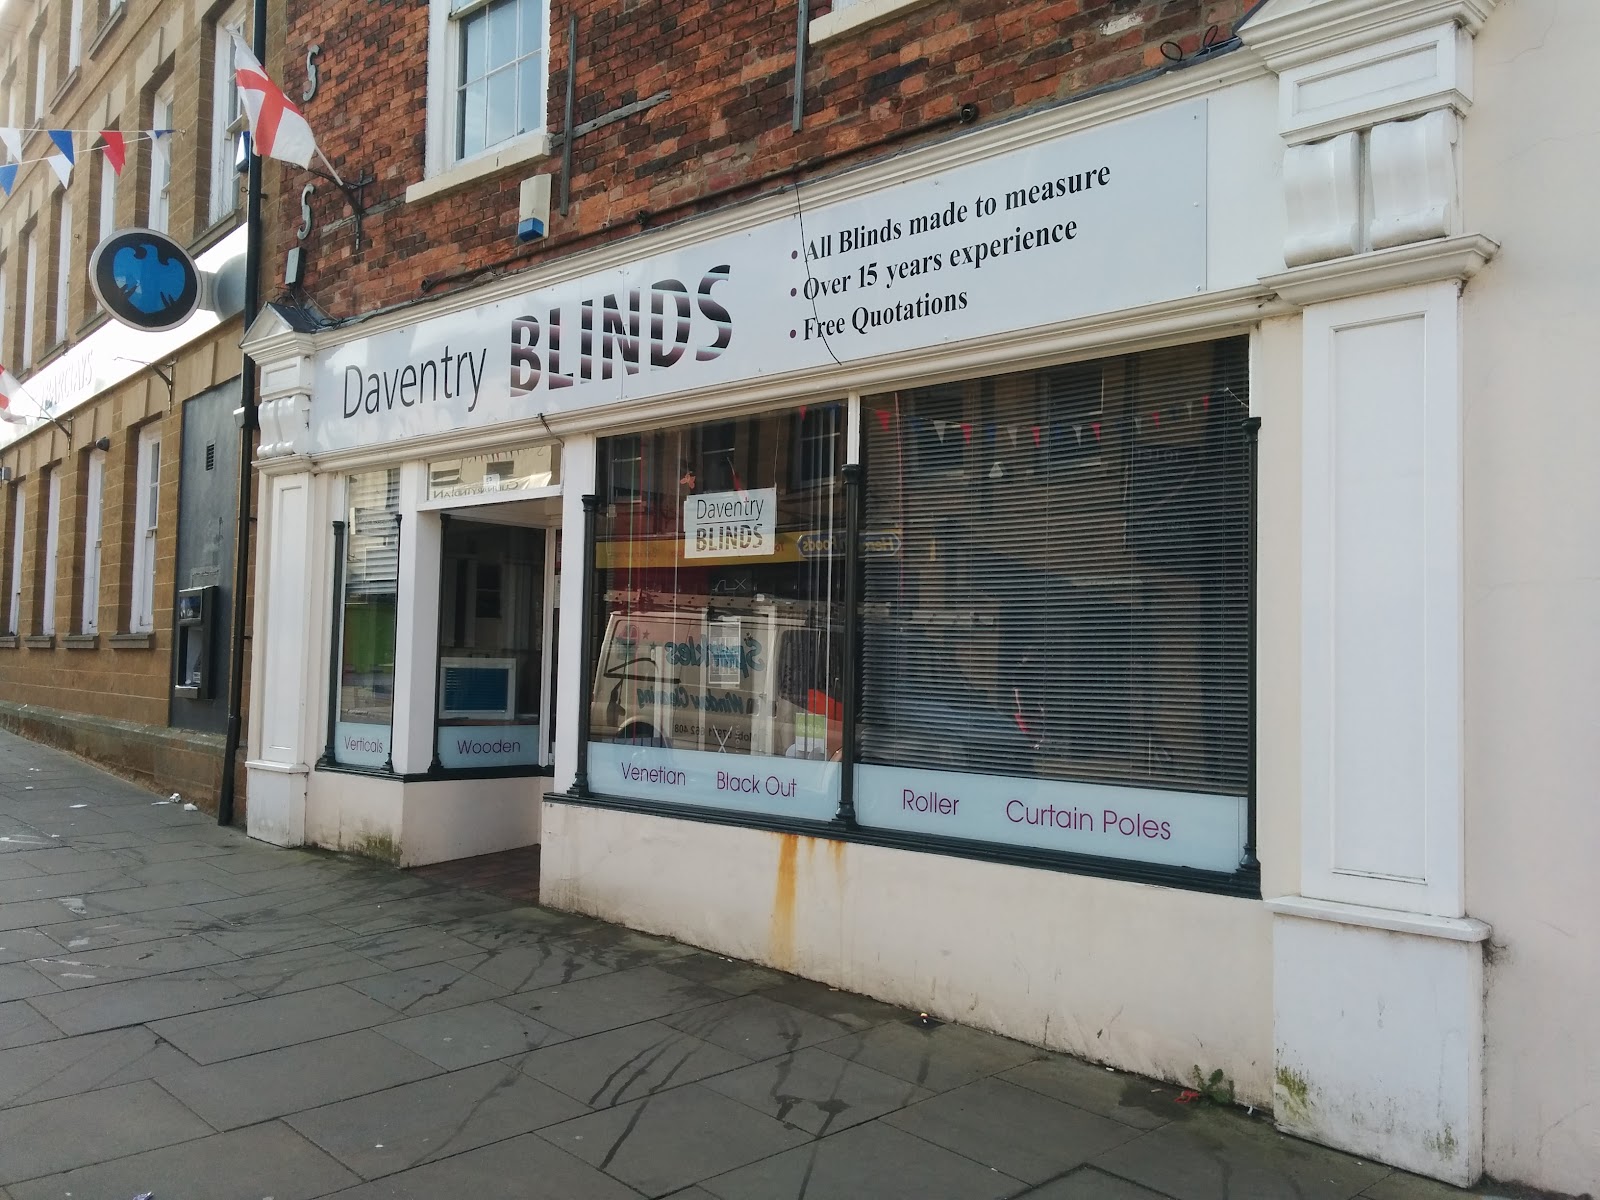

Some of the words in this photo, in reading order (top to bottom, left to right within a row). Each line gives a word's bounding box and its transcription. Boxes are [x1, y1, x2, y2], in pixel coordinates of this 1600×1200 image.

[804, 234, 832, 263] All
[838, 218, 902, 254] Blinds
[909, 202, 969, 236] made
[975, 195, 997, 218] to
[1005, 166, 1111, 211] measure
[803, 274, 851, 300] Over
[858, 262, 878, 288] 15
[886, 251, 942, 288] years
[949, 220, 1078, 269] experience
[803, 315, 846, 340] Free
[851, 290, 968, 334] Quotations
[343, 345, 487, 419] Daventry
[510, 264, 733, 397] BLINDS
[696, 497, 764, 521] Daventry
[696, 523, 763, 552] BLINDS
[344, 735, 383, 754] Verticals
[457, 739, 521, 755] Wooden
[621, 762, 687, 787] Venetian
[716, 771, 761, 795] Black
[765, 776, 797, 799] Out
[902, 789, 960, 817] Roller
[1006, 800, 1094, 833] Curtain
[1103, 810, 1172, 841] Poles
